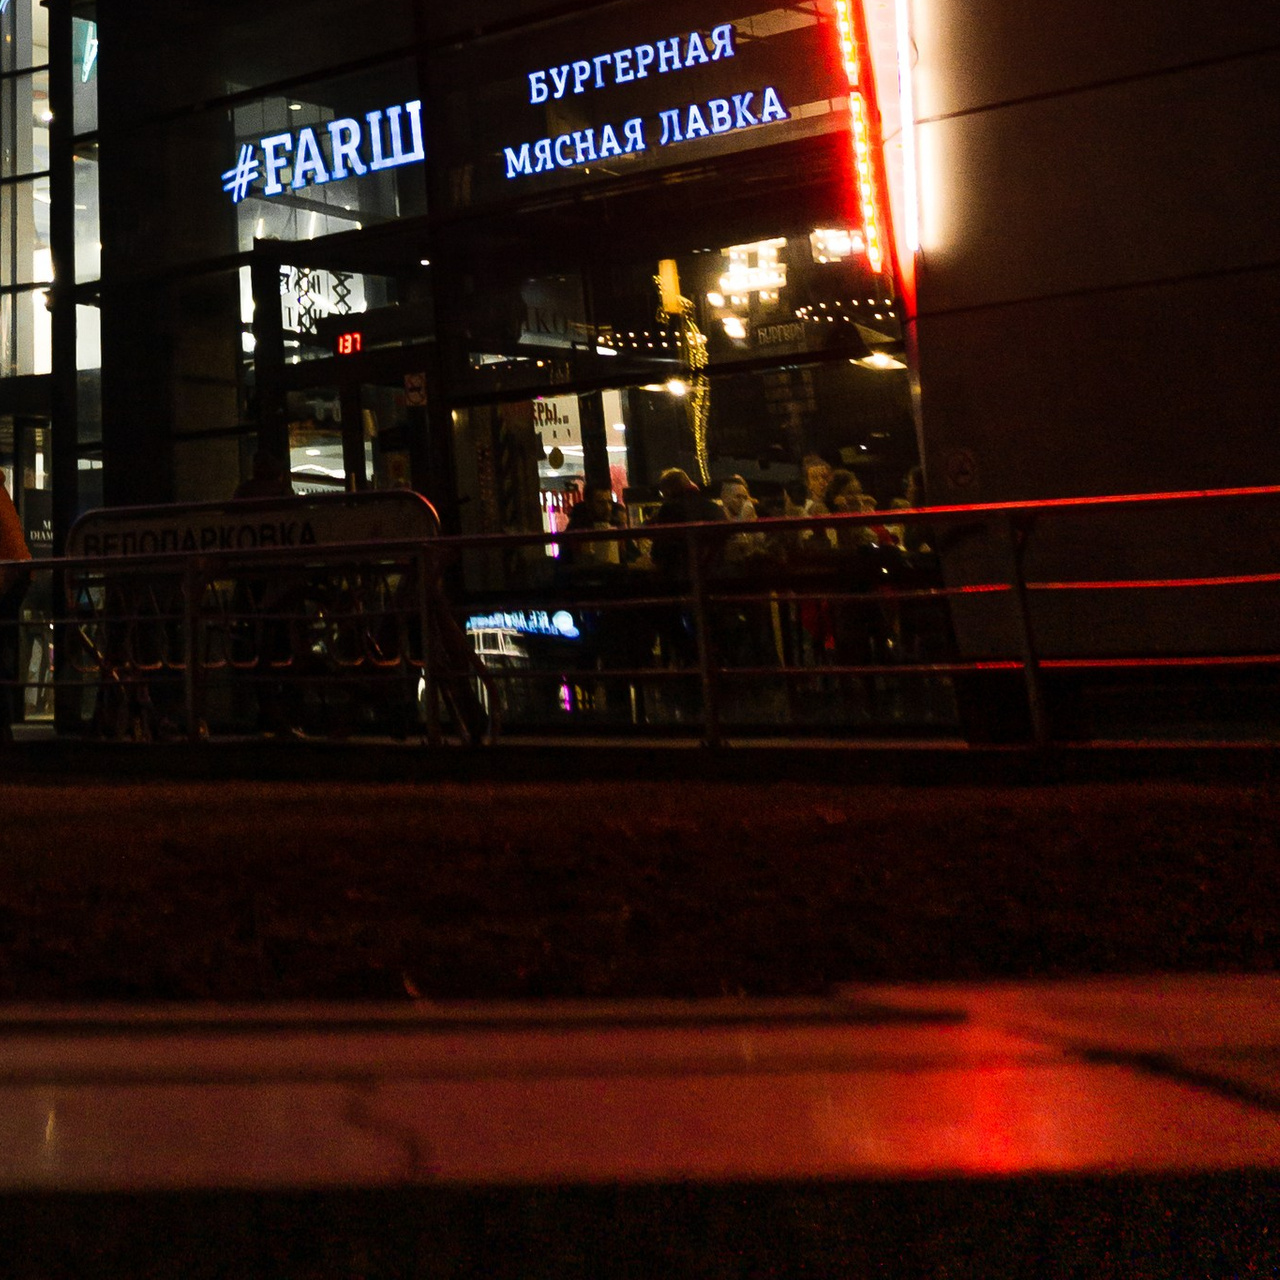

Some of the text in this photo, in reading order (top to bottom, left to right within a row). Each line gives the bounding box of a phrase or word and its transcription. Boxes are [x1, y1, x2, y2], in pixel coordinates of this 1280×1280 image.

[527, 23, 737, 105] БУРГЕРНАЯ
[503, 86, 789, 179] МЯСНАЯ ЛАВКА
[30, 530, 53, 541] DIAM
[83, 521, 317, 557] ВЕЛОПАРКОВКА
